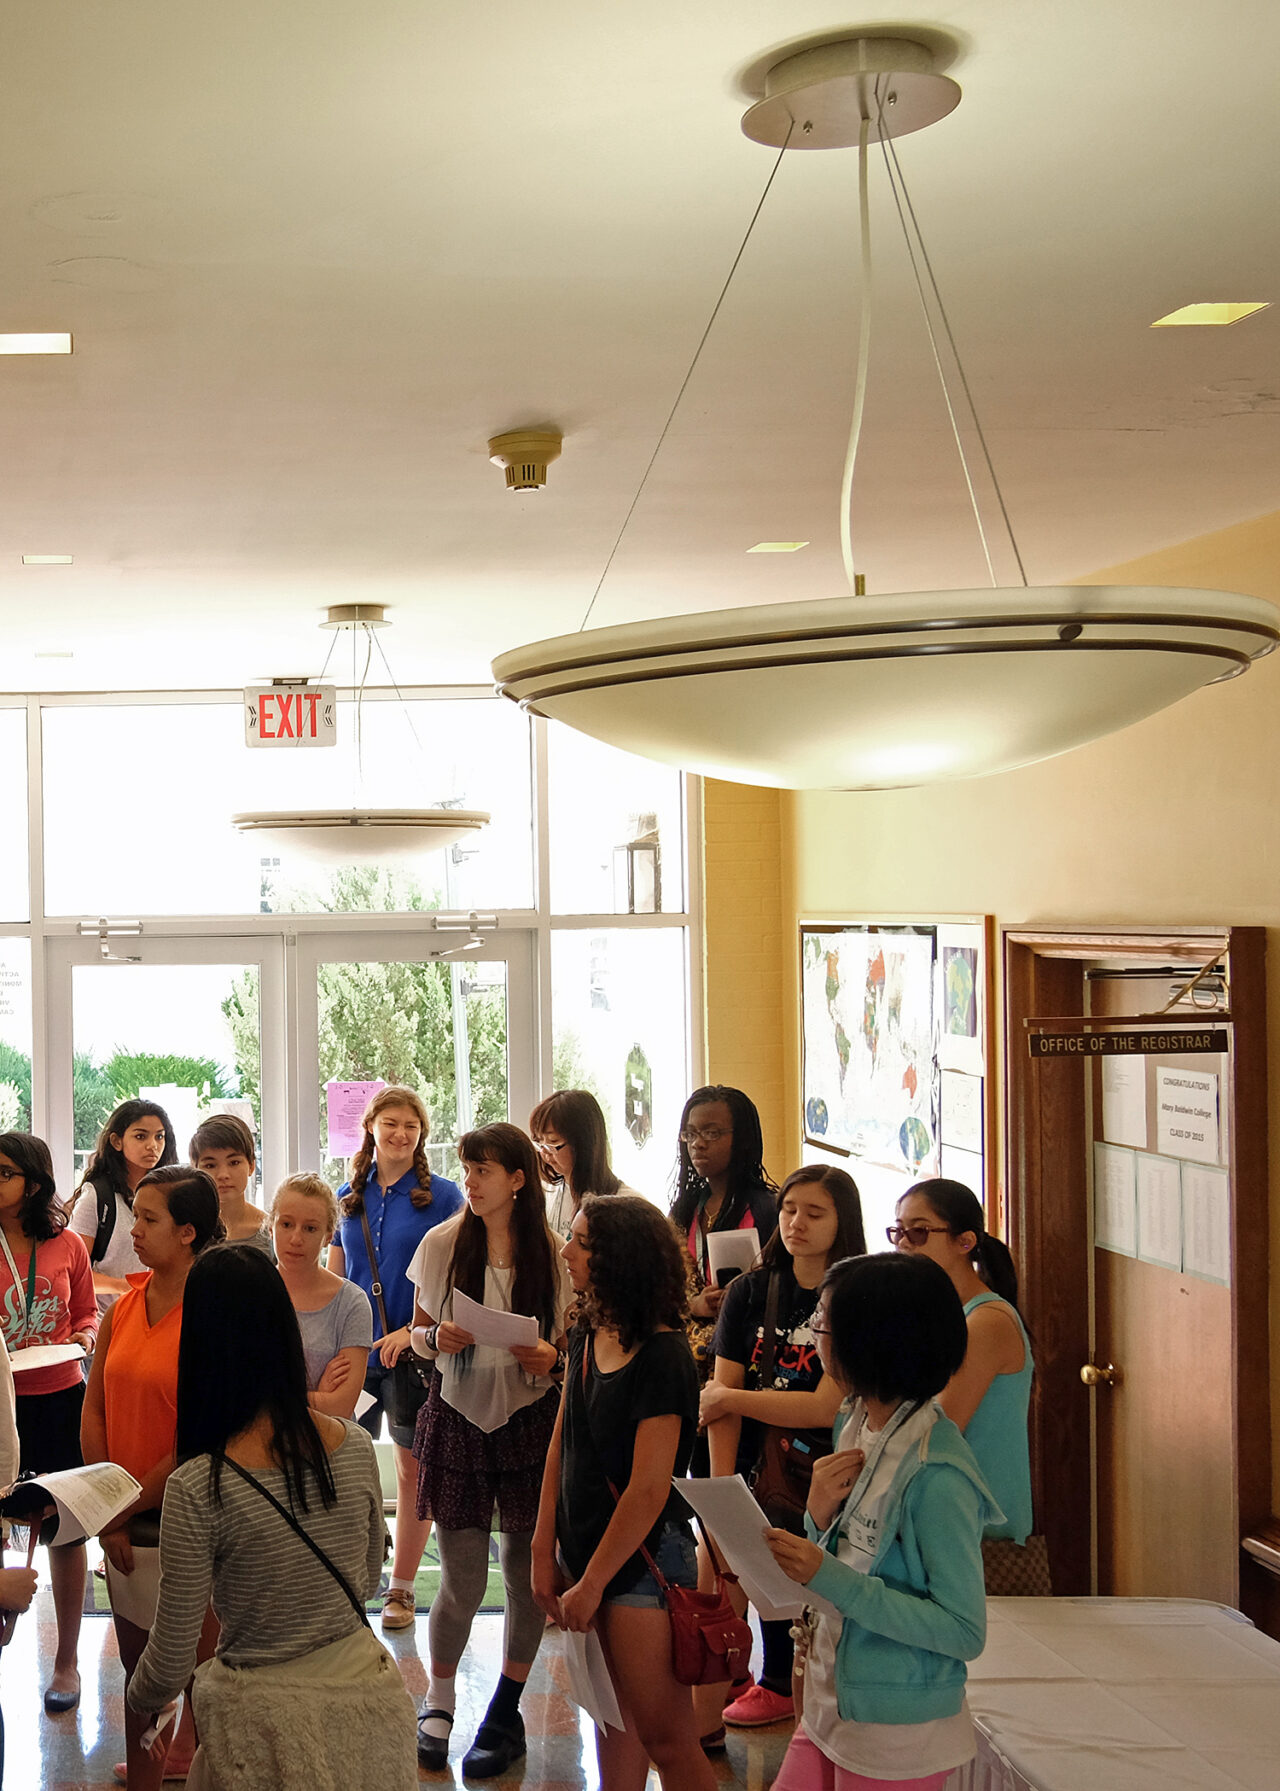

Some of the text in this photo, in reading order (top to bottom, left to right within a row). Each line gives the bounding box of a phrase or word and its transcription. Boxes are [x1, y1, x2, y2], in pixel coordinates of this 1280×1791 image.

[258, 693, 322, 738] EXIT
[1039, 1034, 1212, 1052] OFFICE OF THE REGISTRAR
[1162, 1077, 1210, 1091] CONGRATULATIONS
[1170, 1128, 1184, 1138] CLASS
